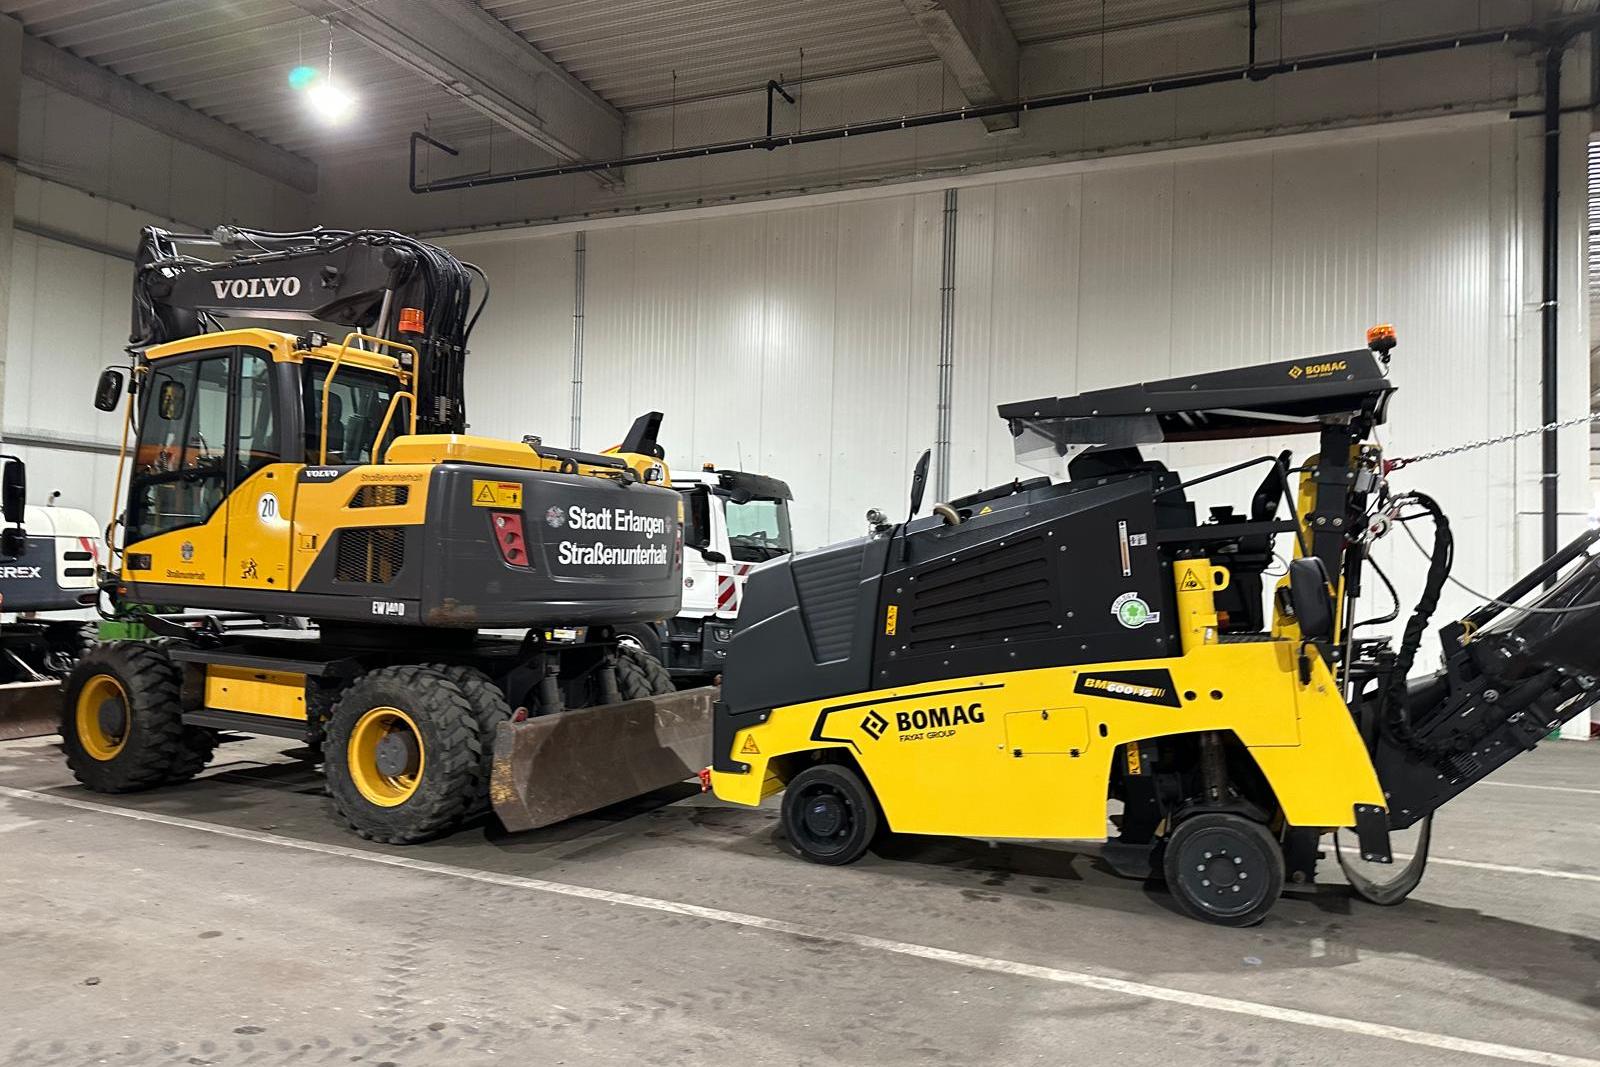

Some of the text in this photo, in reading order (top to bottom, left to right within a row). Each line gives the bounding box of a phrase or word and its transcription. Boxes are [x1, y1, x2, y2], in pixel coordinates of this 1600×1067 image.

[211, 277, 301, 299] VOLVO
[1306, 361, 1347, 375] BOMAG
[262, 498, 275, 517] 20
[568, 505, 665, 539] Stadt Erlangen
[558, 541, 667, 565] Straßenunterhalt
[896, 703, 985, 732] BOMAG
[900, 729, 956, 742] FAYAT GROUP
